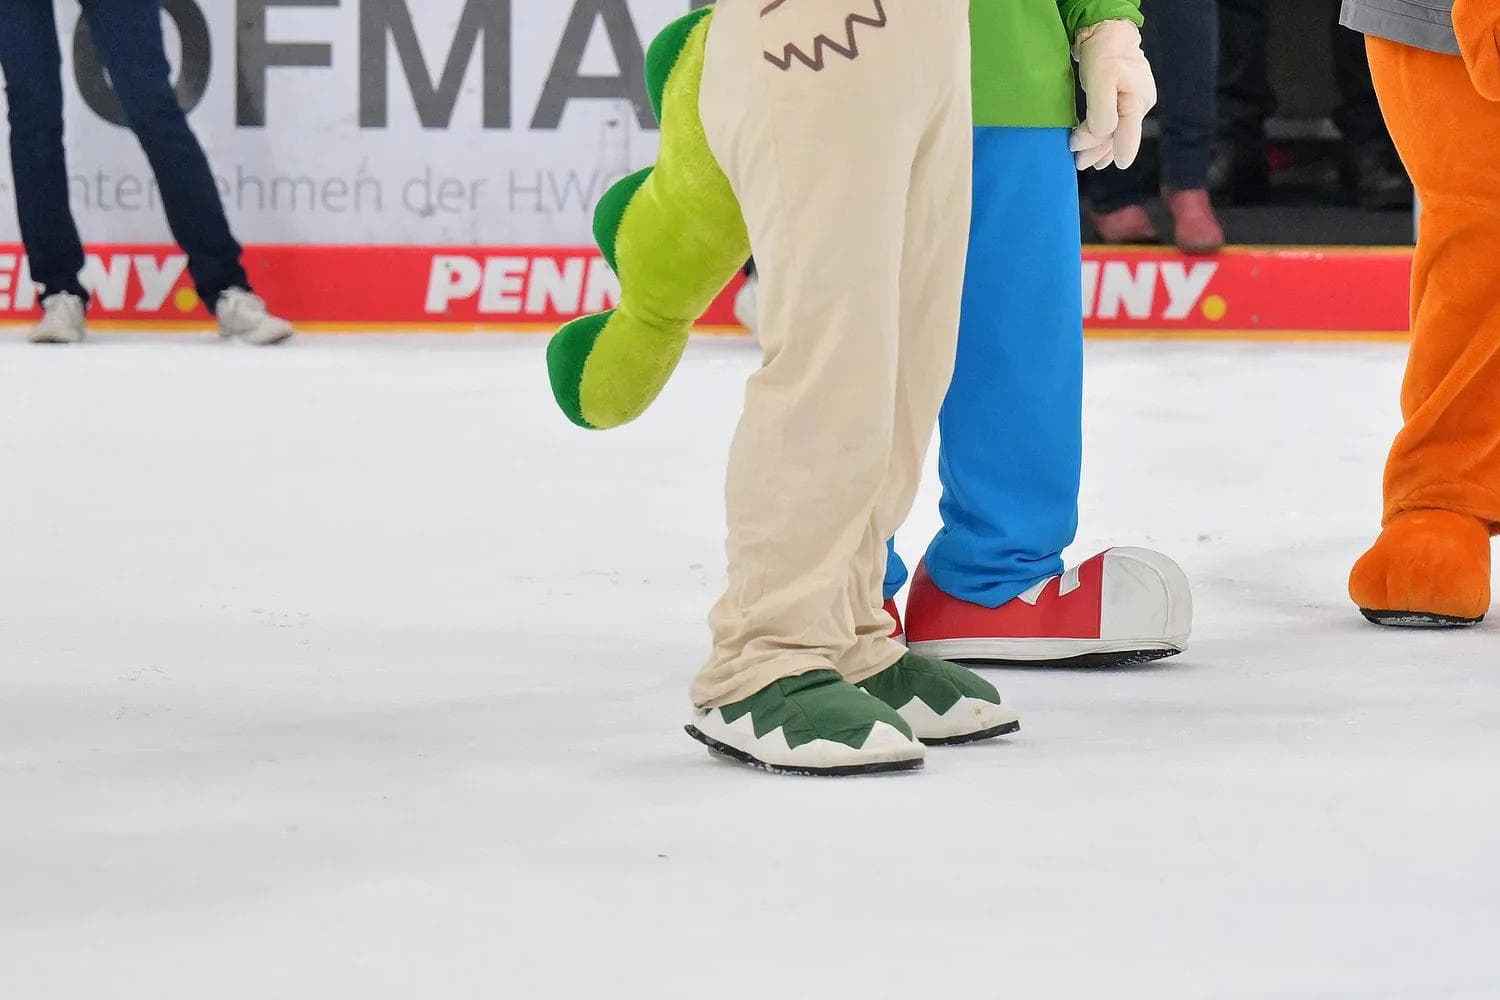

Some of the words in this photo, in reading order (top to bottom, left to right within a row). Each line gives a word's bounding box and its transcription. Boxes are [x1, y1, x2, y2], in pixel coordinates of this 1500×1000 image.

[401, 165, 489, 213] der
[507, 167, 626, 213] HW
[423, 254, 621, 314] PENN
